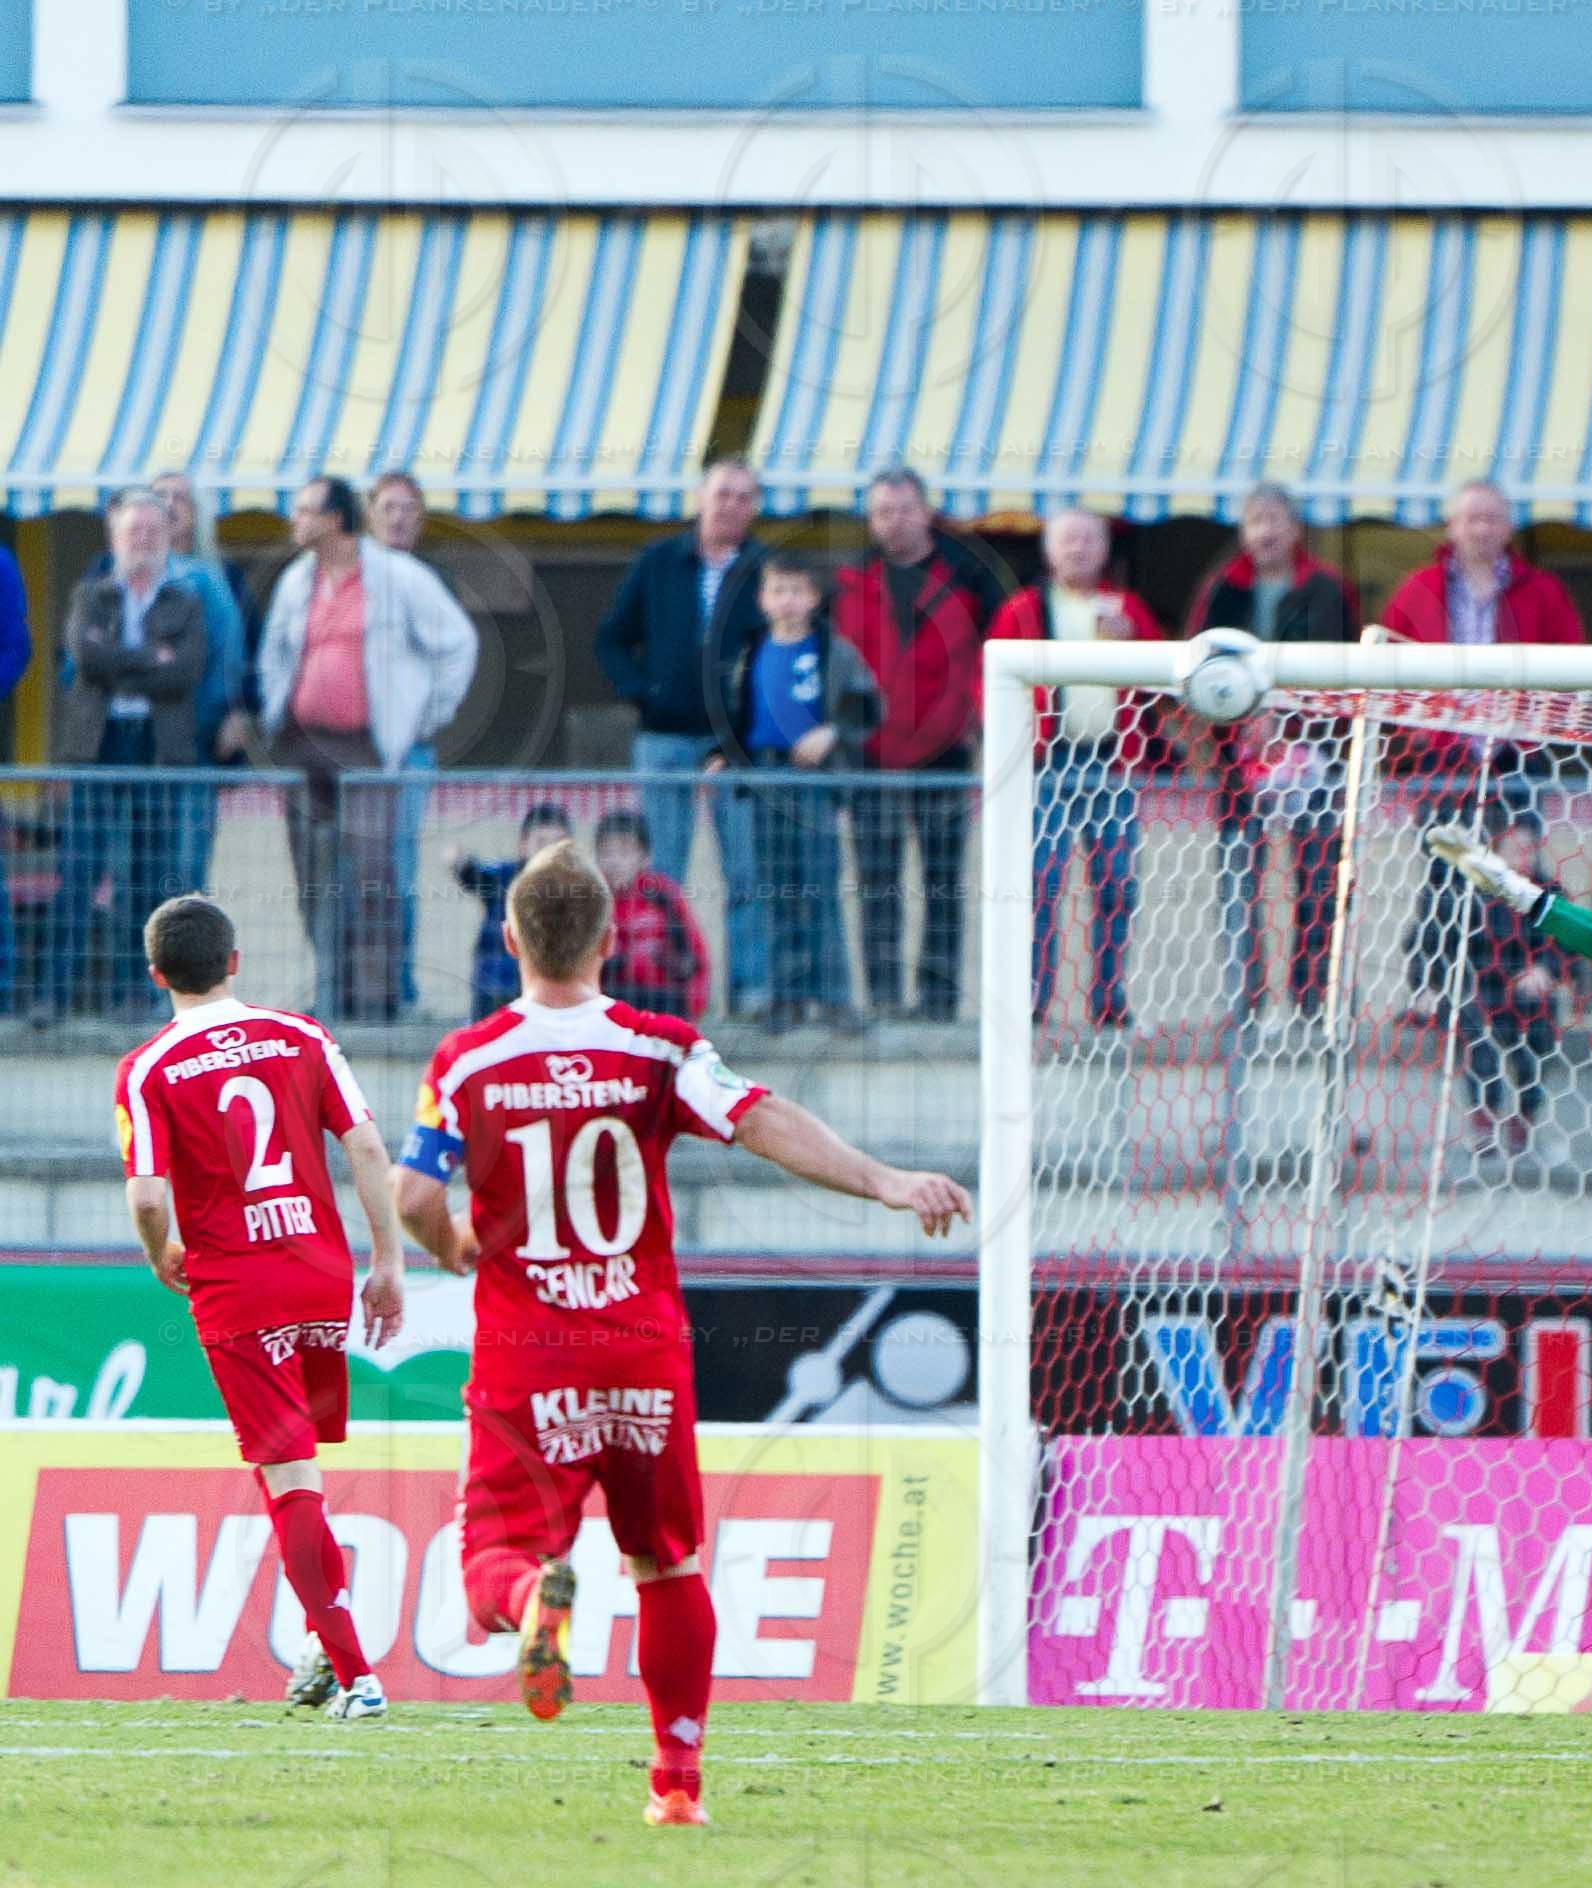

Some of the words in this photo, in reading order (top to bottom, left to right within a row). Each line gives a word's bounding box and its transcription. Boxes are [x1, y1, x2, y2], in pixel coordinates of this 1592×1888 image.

[217, 1075, 294, 1192] 2
[243, 1195, 317, 1244] PITTER
[504, 1116, 648, 1261] 10
[529, 1386, 676, 1431] KLEINE
